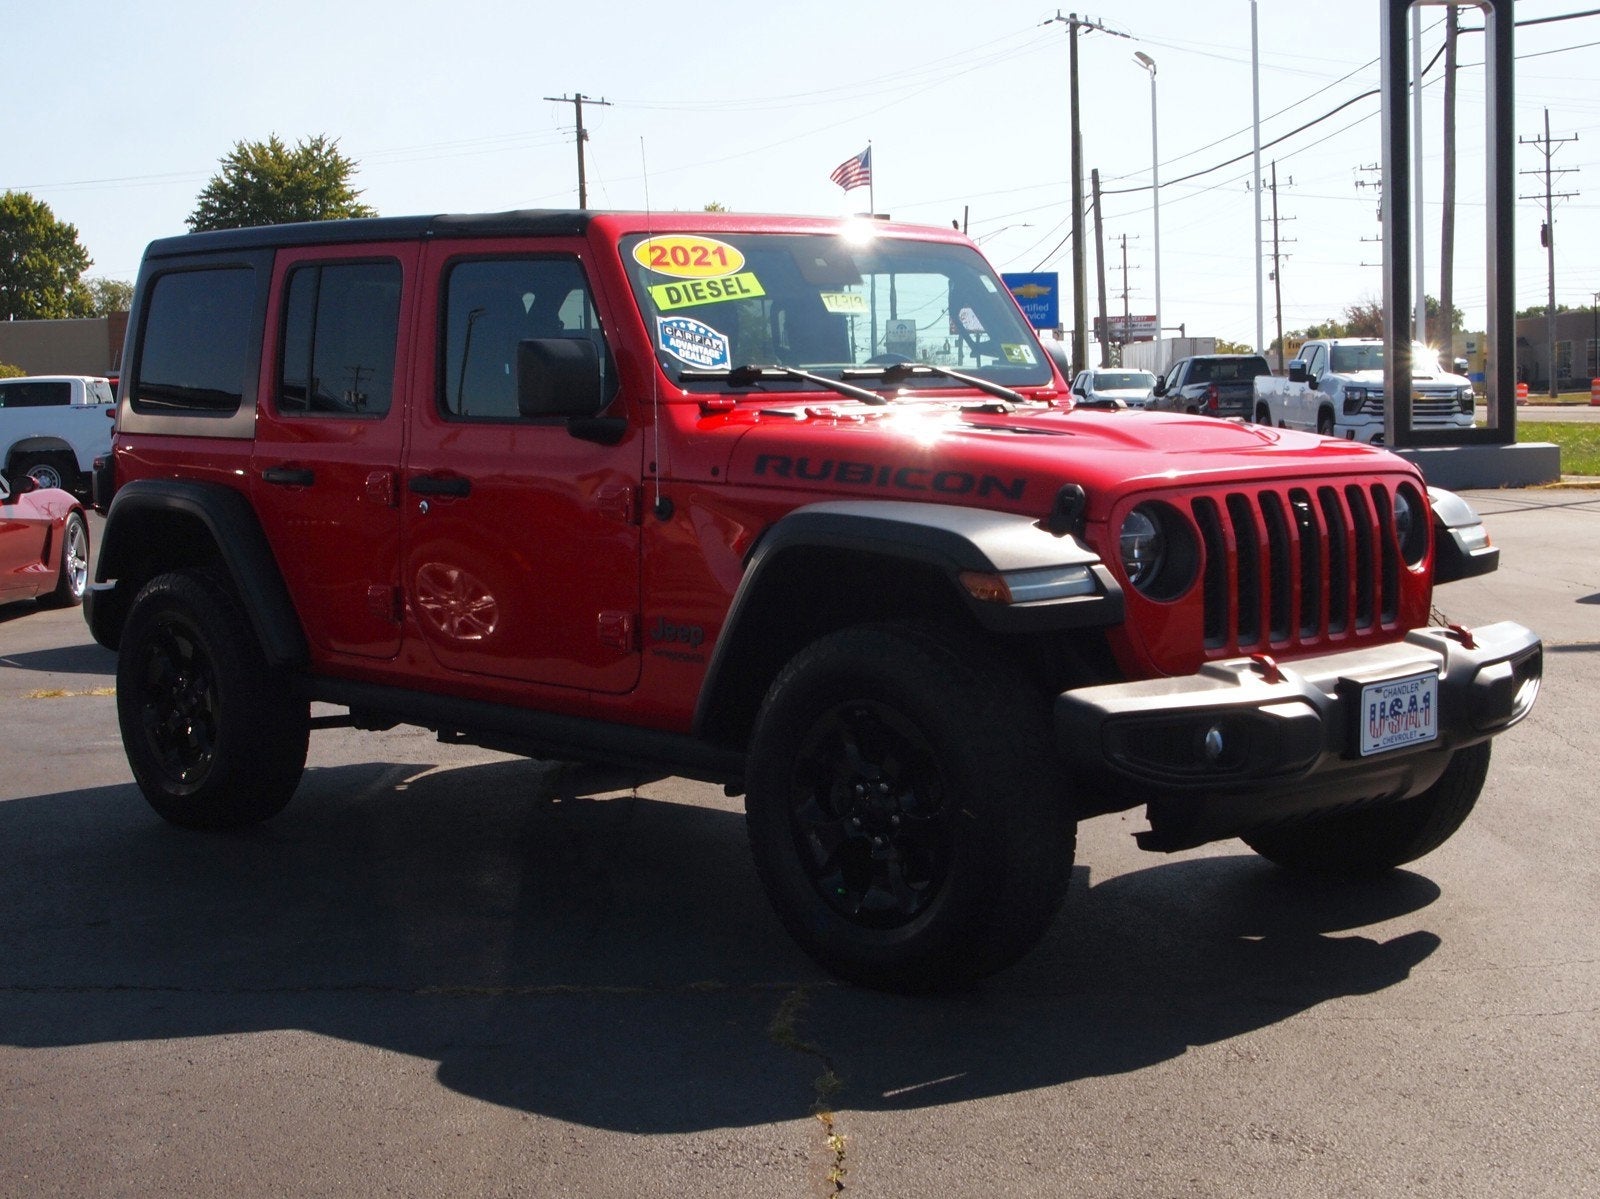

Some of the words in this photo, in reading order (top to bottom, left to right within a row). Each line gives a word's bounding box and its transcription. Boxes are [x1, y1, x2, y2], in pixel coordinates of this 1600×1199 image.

[649, 245, 728, 267] 2021
[665, 277, 751, 305] DIESEL
[665, 326, 722, 350] CARFAX
[670, 337, 721, 359] ADVANTAGE
[679, 348, 713, 366] DEALER
[754, 454, 1028, 500] RUBICON
[650, 616, 704, 650] Jeep
[1383, 683, 1419, 698] CHANDLER
[1382, 730, 1417, 745] CHEVROLET
